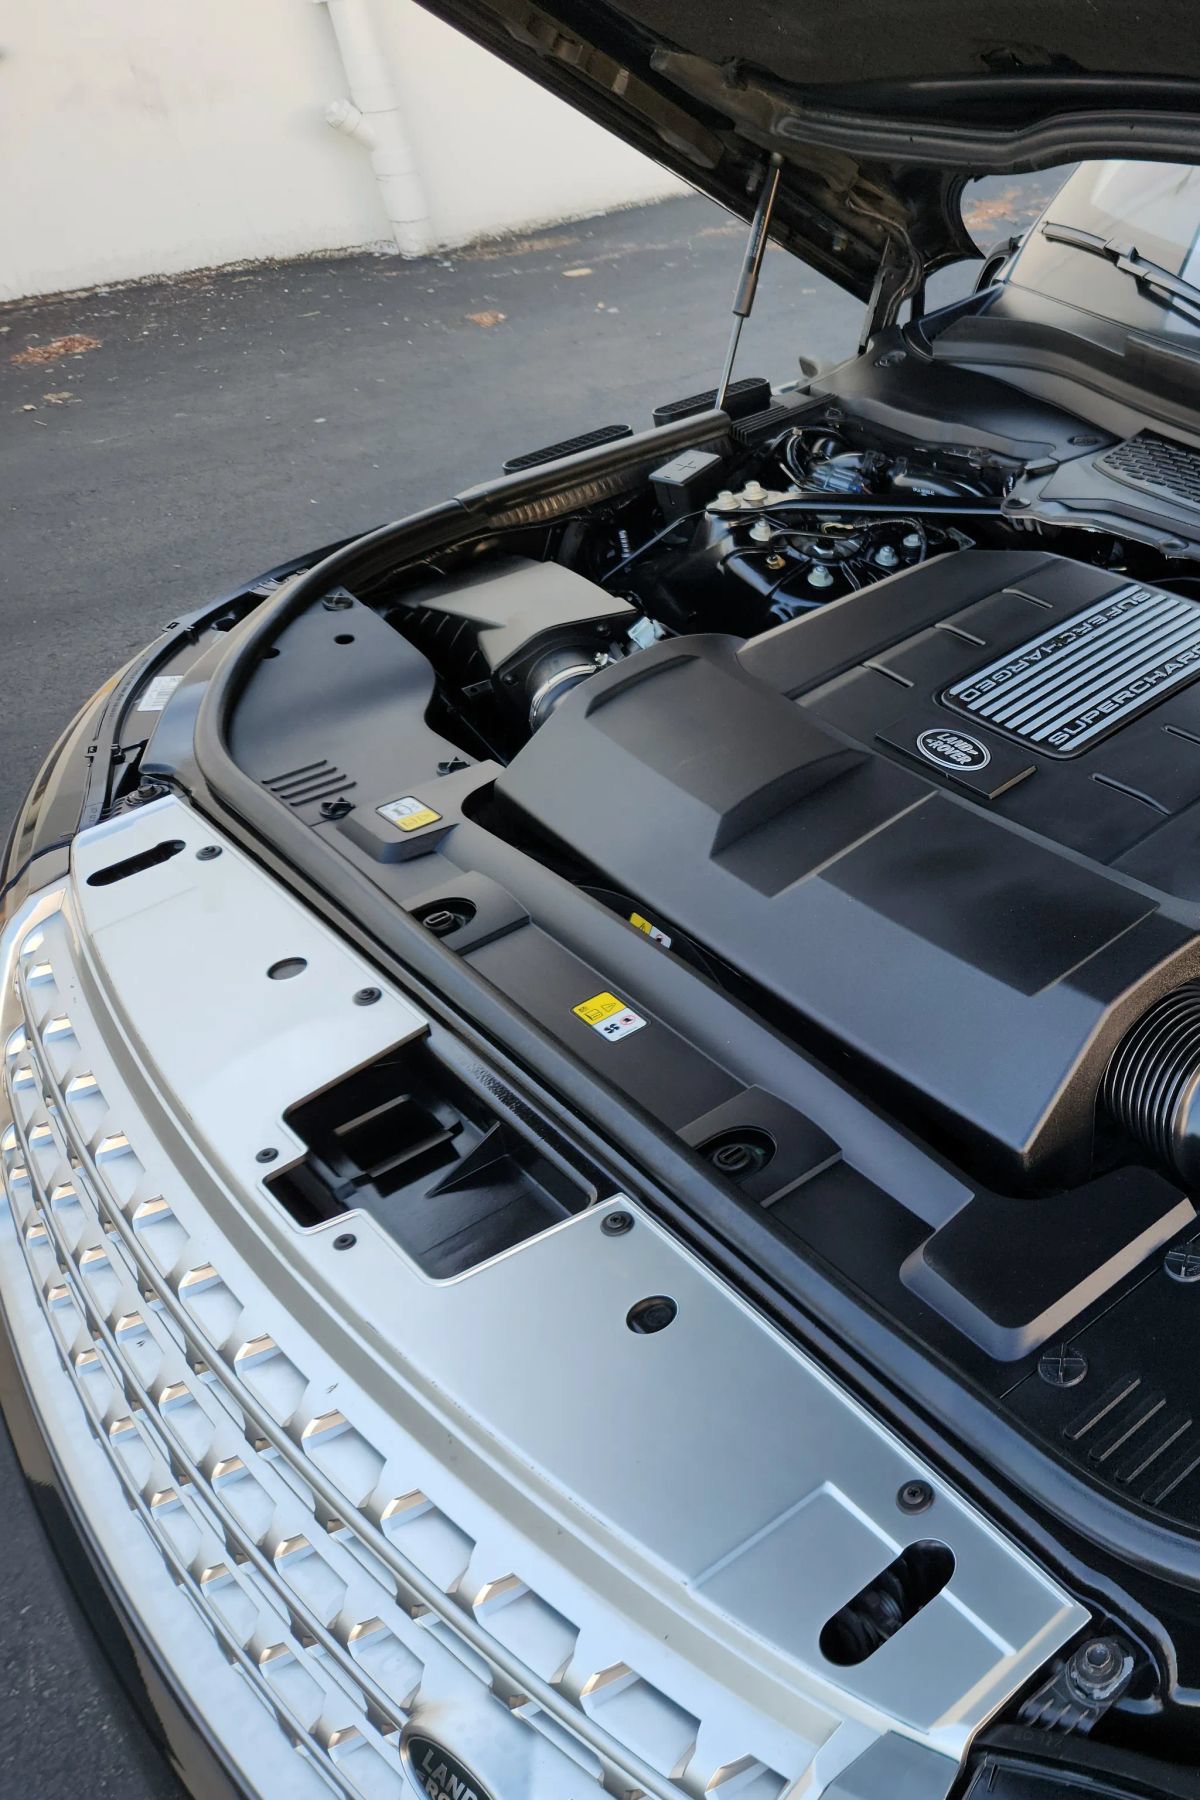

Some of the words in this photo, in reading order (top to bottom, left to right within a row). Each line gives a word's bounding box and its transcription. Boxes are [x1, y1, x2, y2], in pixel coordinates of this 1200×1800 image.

[958, 590, 1152, 702] SUPERCHARGED
[928, 740, 972, 765] ROVER
[936, 733, 974, 752] LAND
